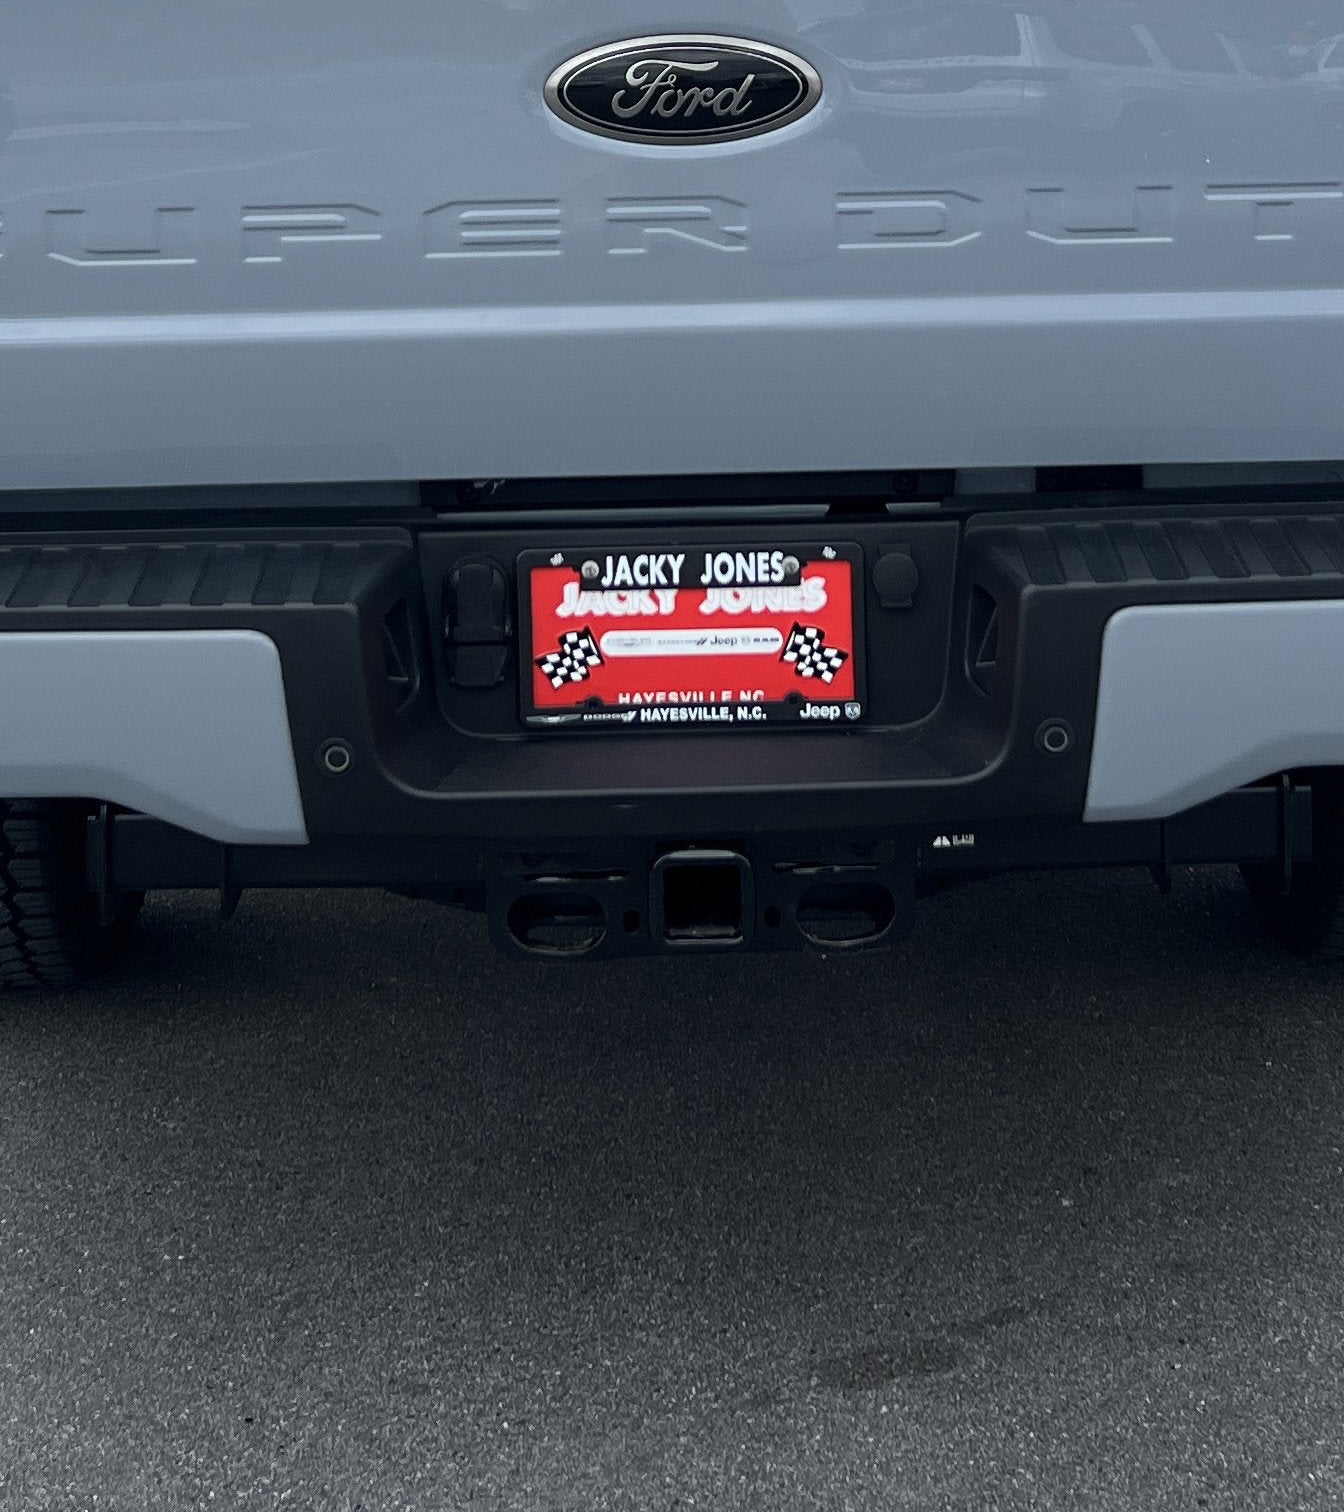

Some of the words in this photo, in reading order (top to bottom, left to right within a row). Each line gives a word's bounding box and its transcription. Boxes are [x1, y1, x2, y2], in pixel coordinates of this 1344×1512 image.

[611, 58, 756, 119] Ford
[602, 552, 686, 587] JACKY
[700, 550, 785, 585] JONES
[709, 635, 738, 646] Jeep
[640, 705, 734, 722] HAYESVILLE,
[737, 705, 767, 721] N.C.
[799, 702, 841, 721] Jeep
